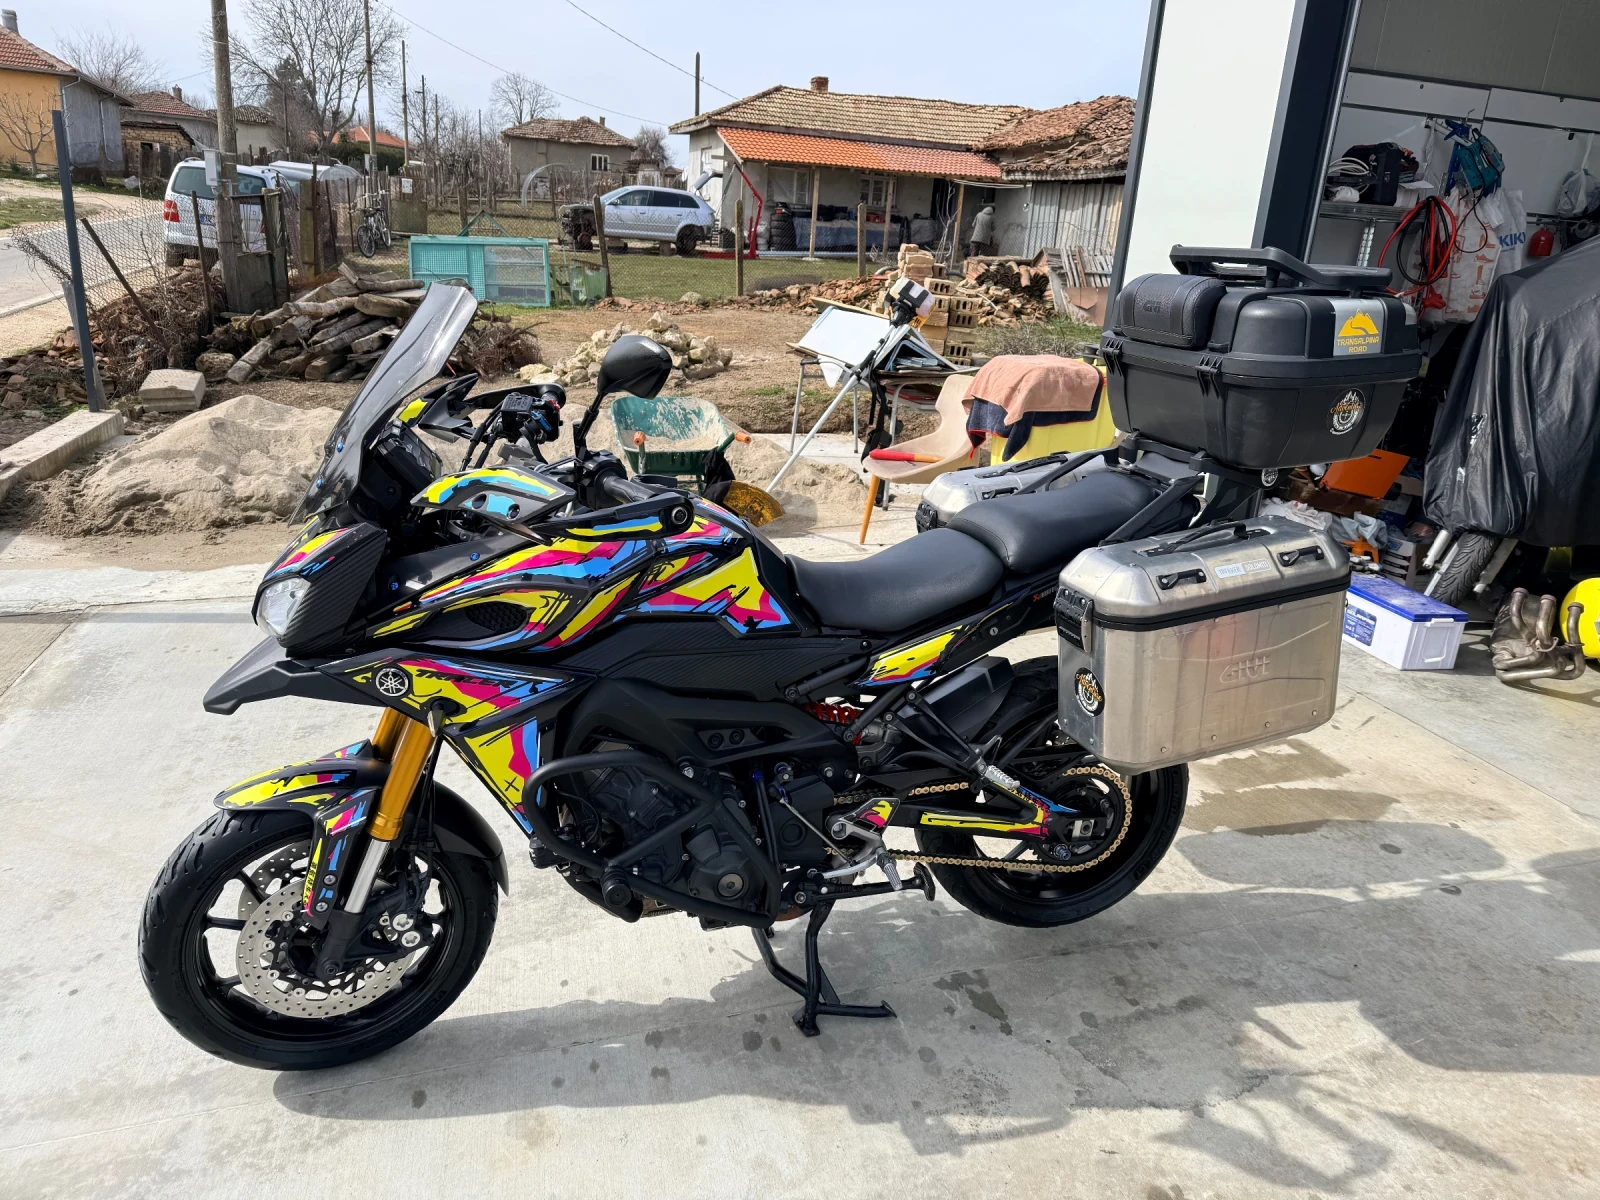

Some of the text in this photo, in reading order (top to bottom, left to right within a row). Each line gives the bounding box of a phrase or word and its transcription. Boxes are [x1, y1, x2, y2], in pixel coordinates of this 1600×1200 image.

[1336, 336, 1380, 346] TRANSALPINA
[1348, 345, 1368, 354] ROAD
[1220, 656, 1270, 683] GIVI
[415, 668, 518, 689] TRACER
